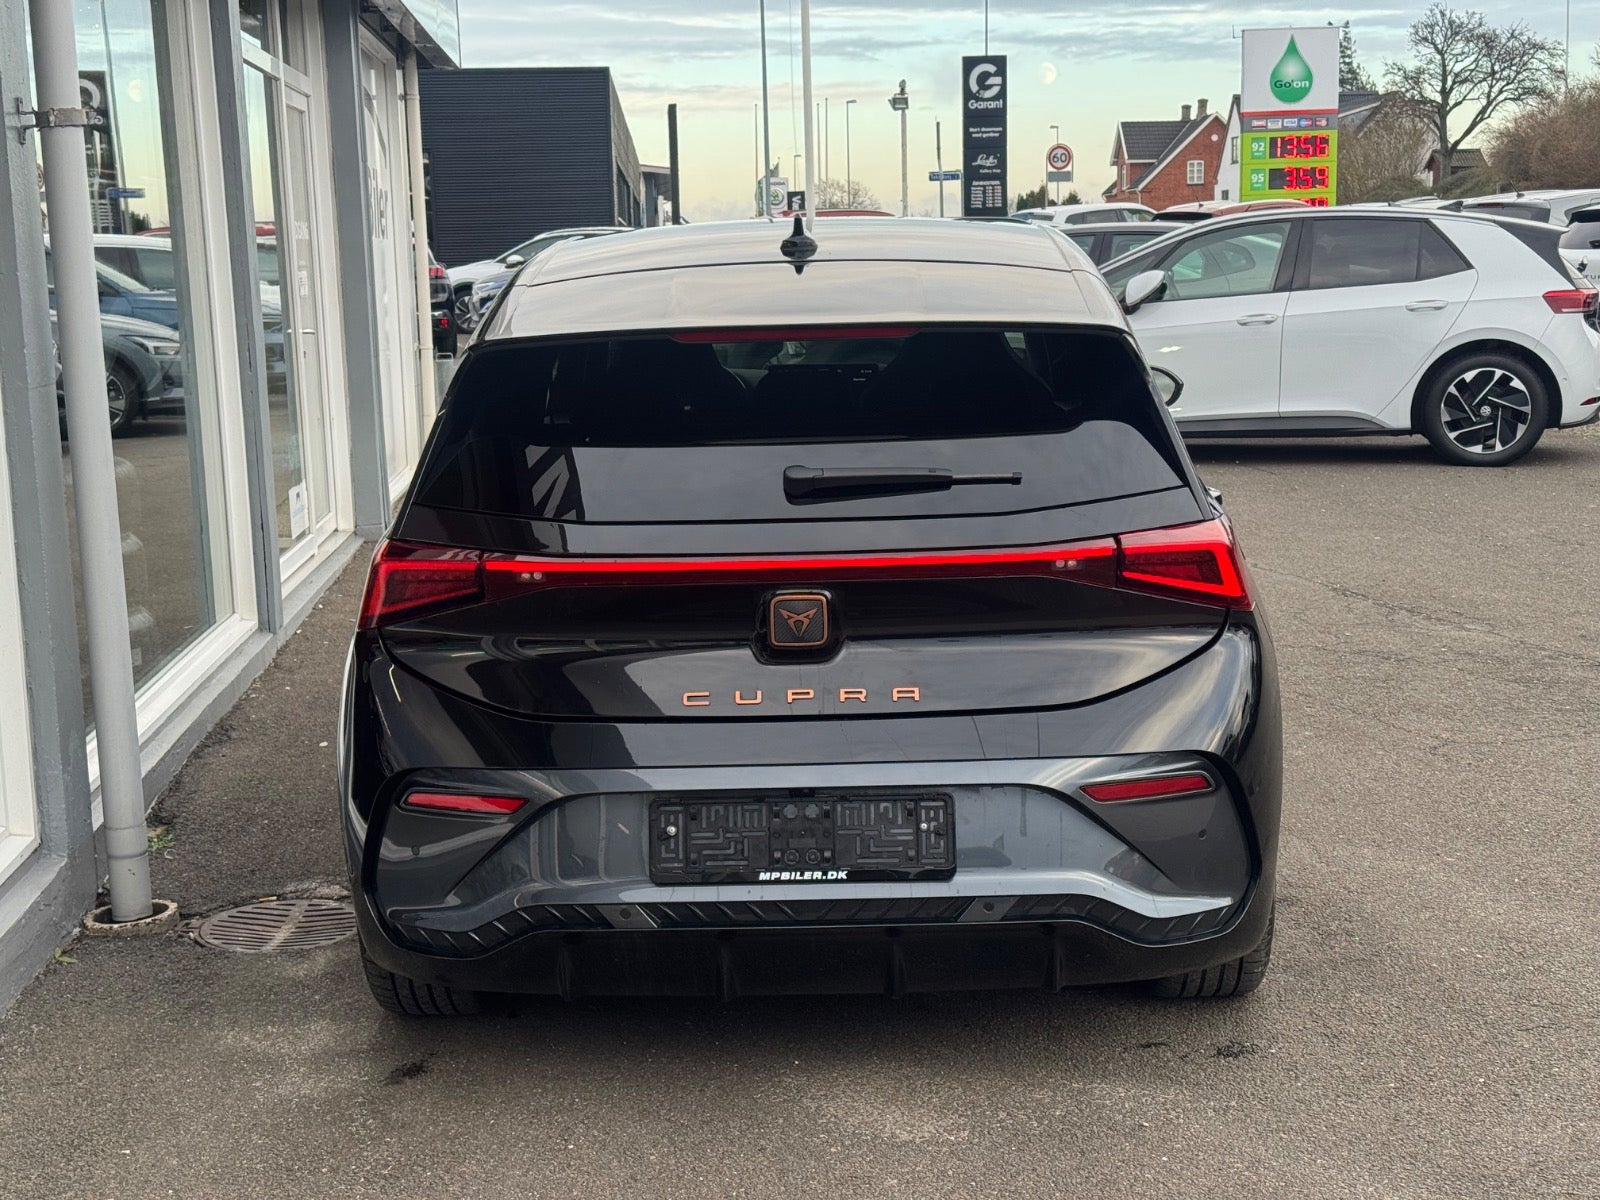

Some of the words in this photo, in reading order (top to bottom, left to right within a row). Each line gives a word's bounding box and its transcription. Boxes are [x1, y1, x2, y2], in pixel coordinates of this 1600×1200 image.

[1274, 80, 1309, 89] Go'on
[968, 99, 1003, 109] Garant
[1251, 142, 1265, 152] 92
[1052, 152, 1067, 163] 60
[1251, 173, 1265, 183] 95
[682, 687, 921, 707] CUPRA
[758, 869, 848, 881] MPBILER.DK
